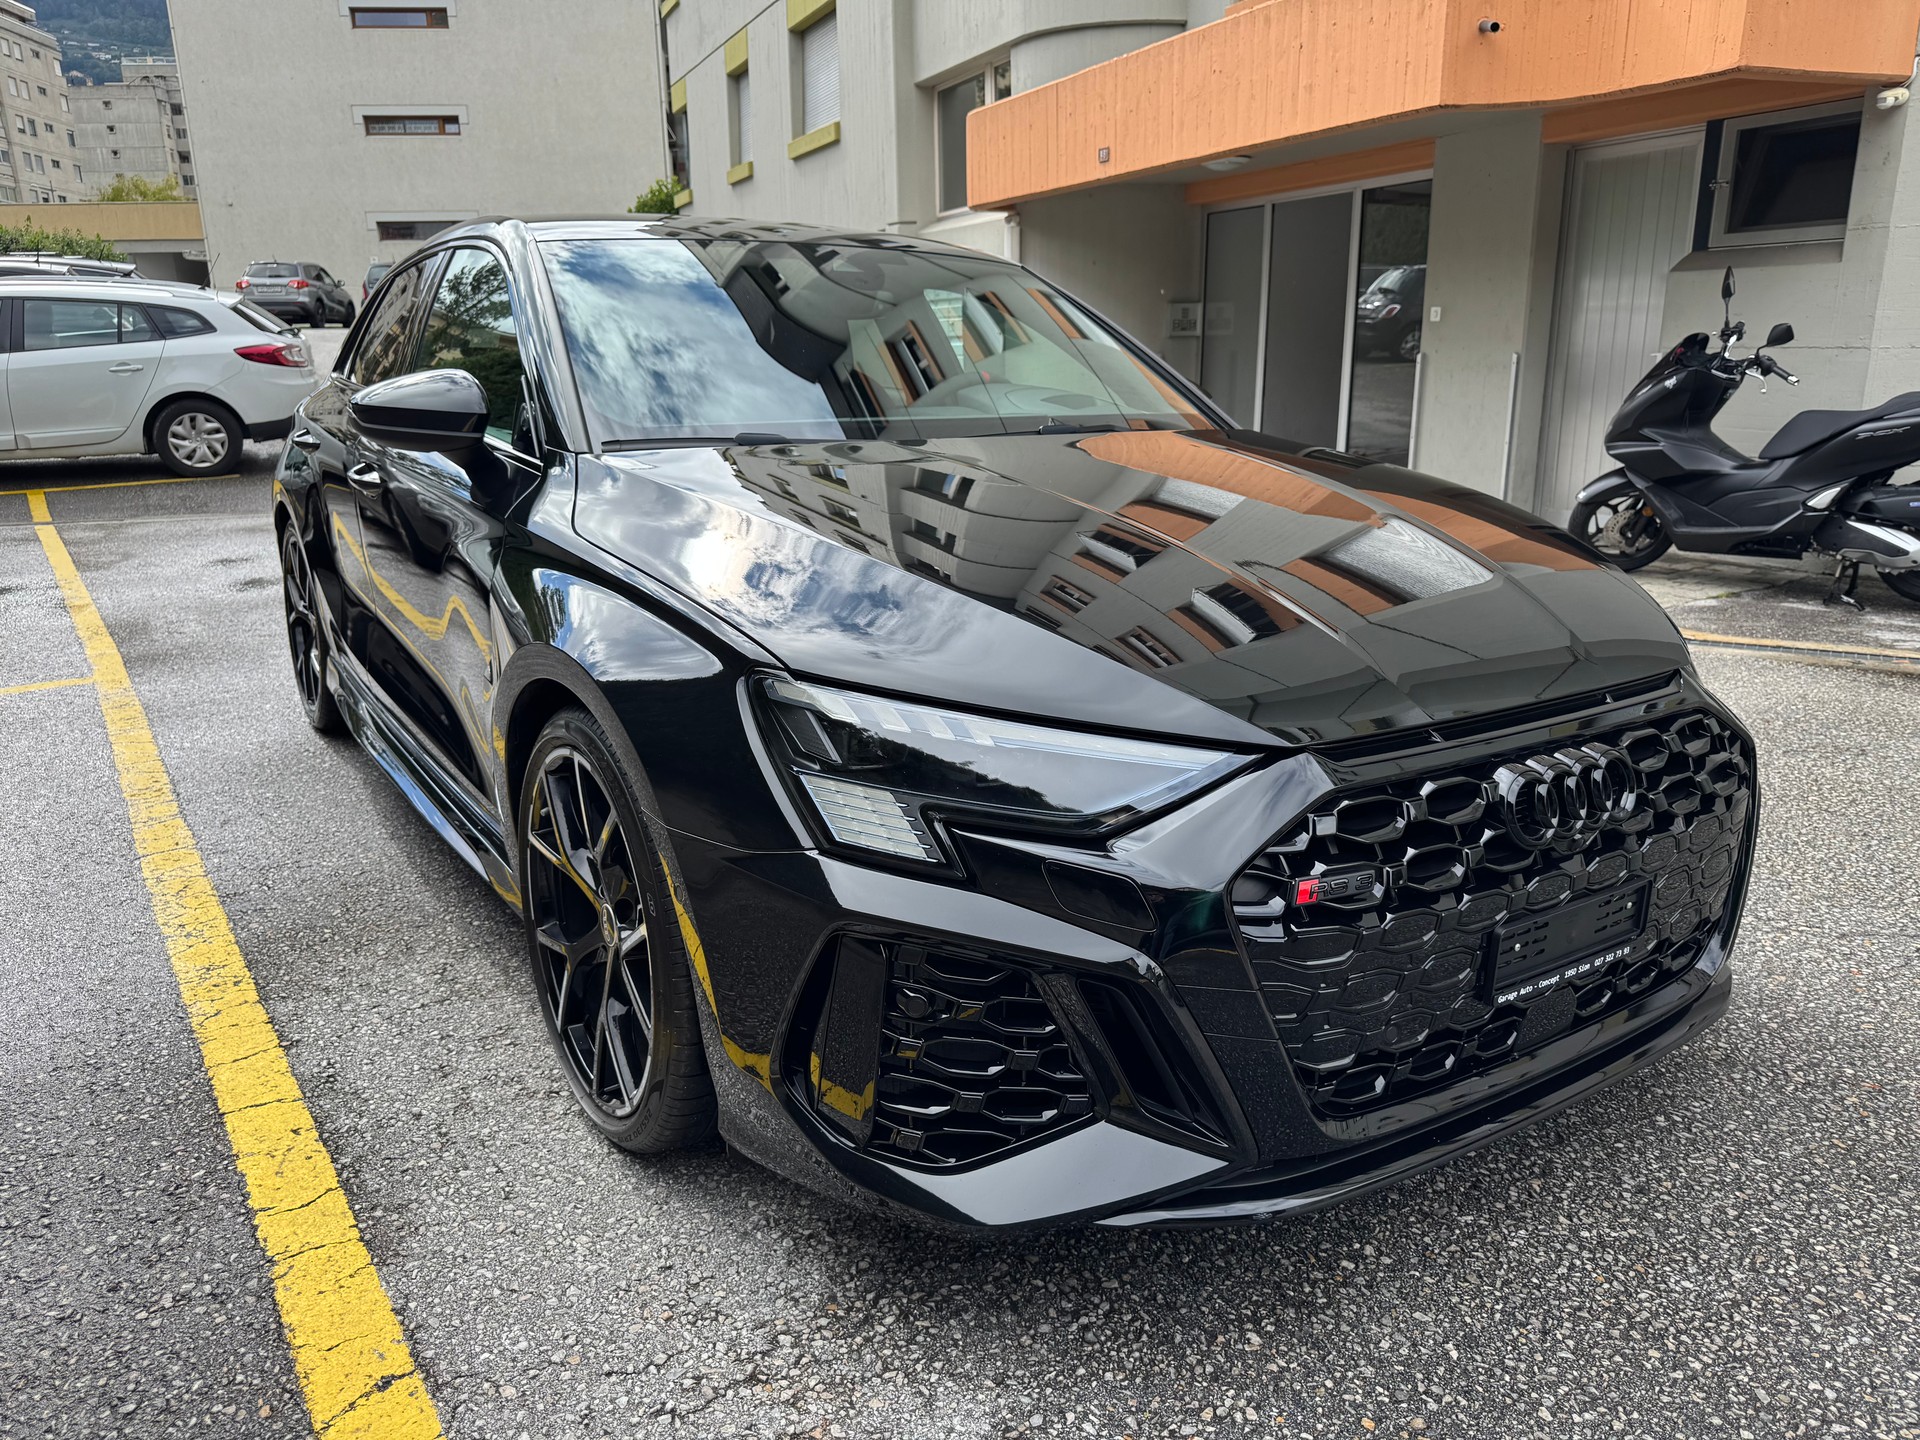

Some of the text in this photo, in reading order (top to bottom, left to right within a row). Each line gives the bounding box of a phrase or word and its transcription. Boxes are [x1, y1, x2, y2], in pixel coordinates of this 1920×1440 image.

[1309, 873, 1374, 900] RS 3
[1497, 991, 1518, 1004] Garage
[1519, 985, 1533, 996] Auto
[1538, 974, 1560, 988] Concept
[1578, 963, 1591, 973] Sion
[1594, 957, 1604, 967] 027
[1605, 952, 1615, 963] 322
[1616, 949, 1622, 958] 73
